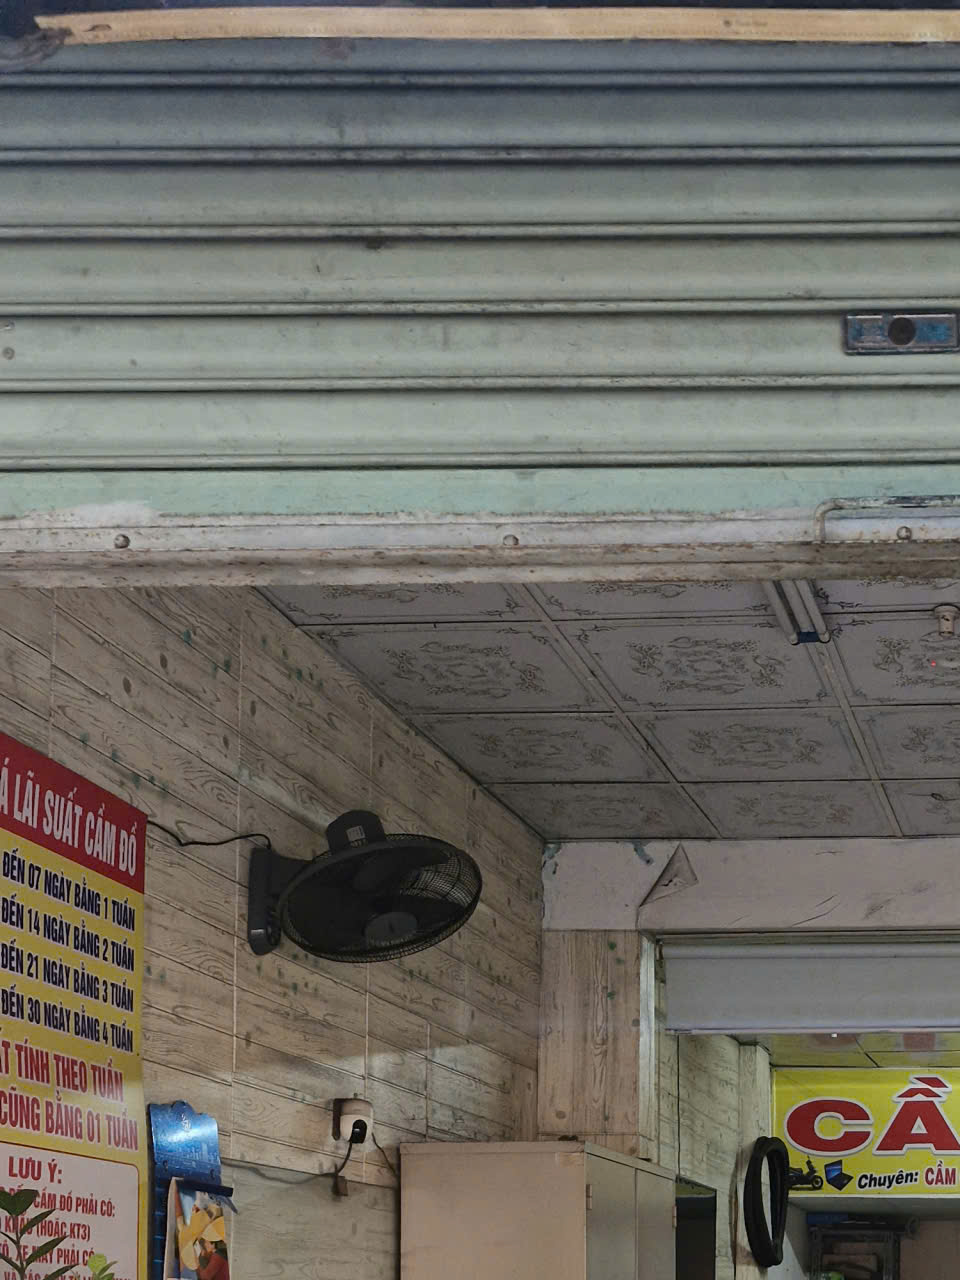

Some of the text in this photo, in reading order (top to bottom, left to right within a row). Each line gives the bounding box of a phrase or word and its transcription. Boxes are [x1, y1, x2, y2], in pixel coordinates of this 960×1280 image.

[13, 770, 40, 829] LÃI
[42, 787, 83, 849] SUẤT
[2, 848, 135, 932] ĐẾN 07 NGÀY BẰNG 1 TUẦN
[1, 893, 135, 972] ĐẾN 14 NGÀY BẰNG 2 TUẦN
[1, 938, 134, 1012] ĐẾN 21 NGÀY BẰNG 3 TUẦN
[1, 984, 134, 1053] ĐẾN 30 NGÀY BẰNG 4 TUẦN
[14, 1038, 50, 1084] TÍNH
[53, 1053, 88, 1094] THEO
[90, 1058, 124, 1102] TUẦN
[0, 1086, 41, 1132] CŨNG
[45, 1090, 83, 1140] BẰNG
[86, 1110, 101, 1144] 01
[8, 1156, 63, 1184] LƯU Ý:
[857, 1170, 919, 1189] Chuyên:
[924, 1160, 956, 1186] CẦM
[69, 1223, 91, 1242] KT3)
[75, 1193, 98, 1215] PHẢI
[100, 1198, 116, 1217] CÓ:
[56, 1243, 80, 1265] PHẢI
